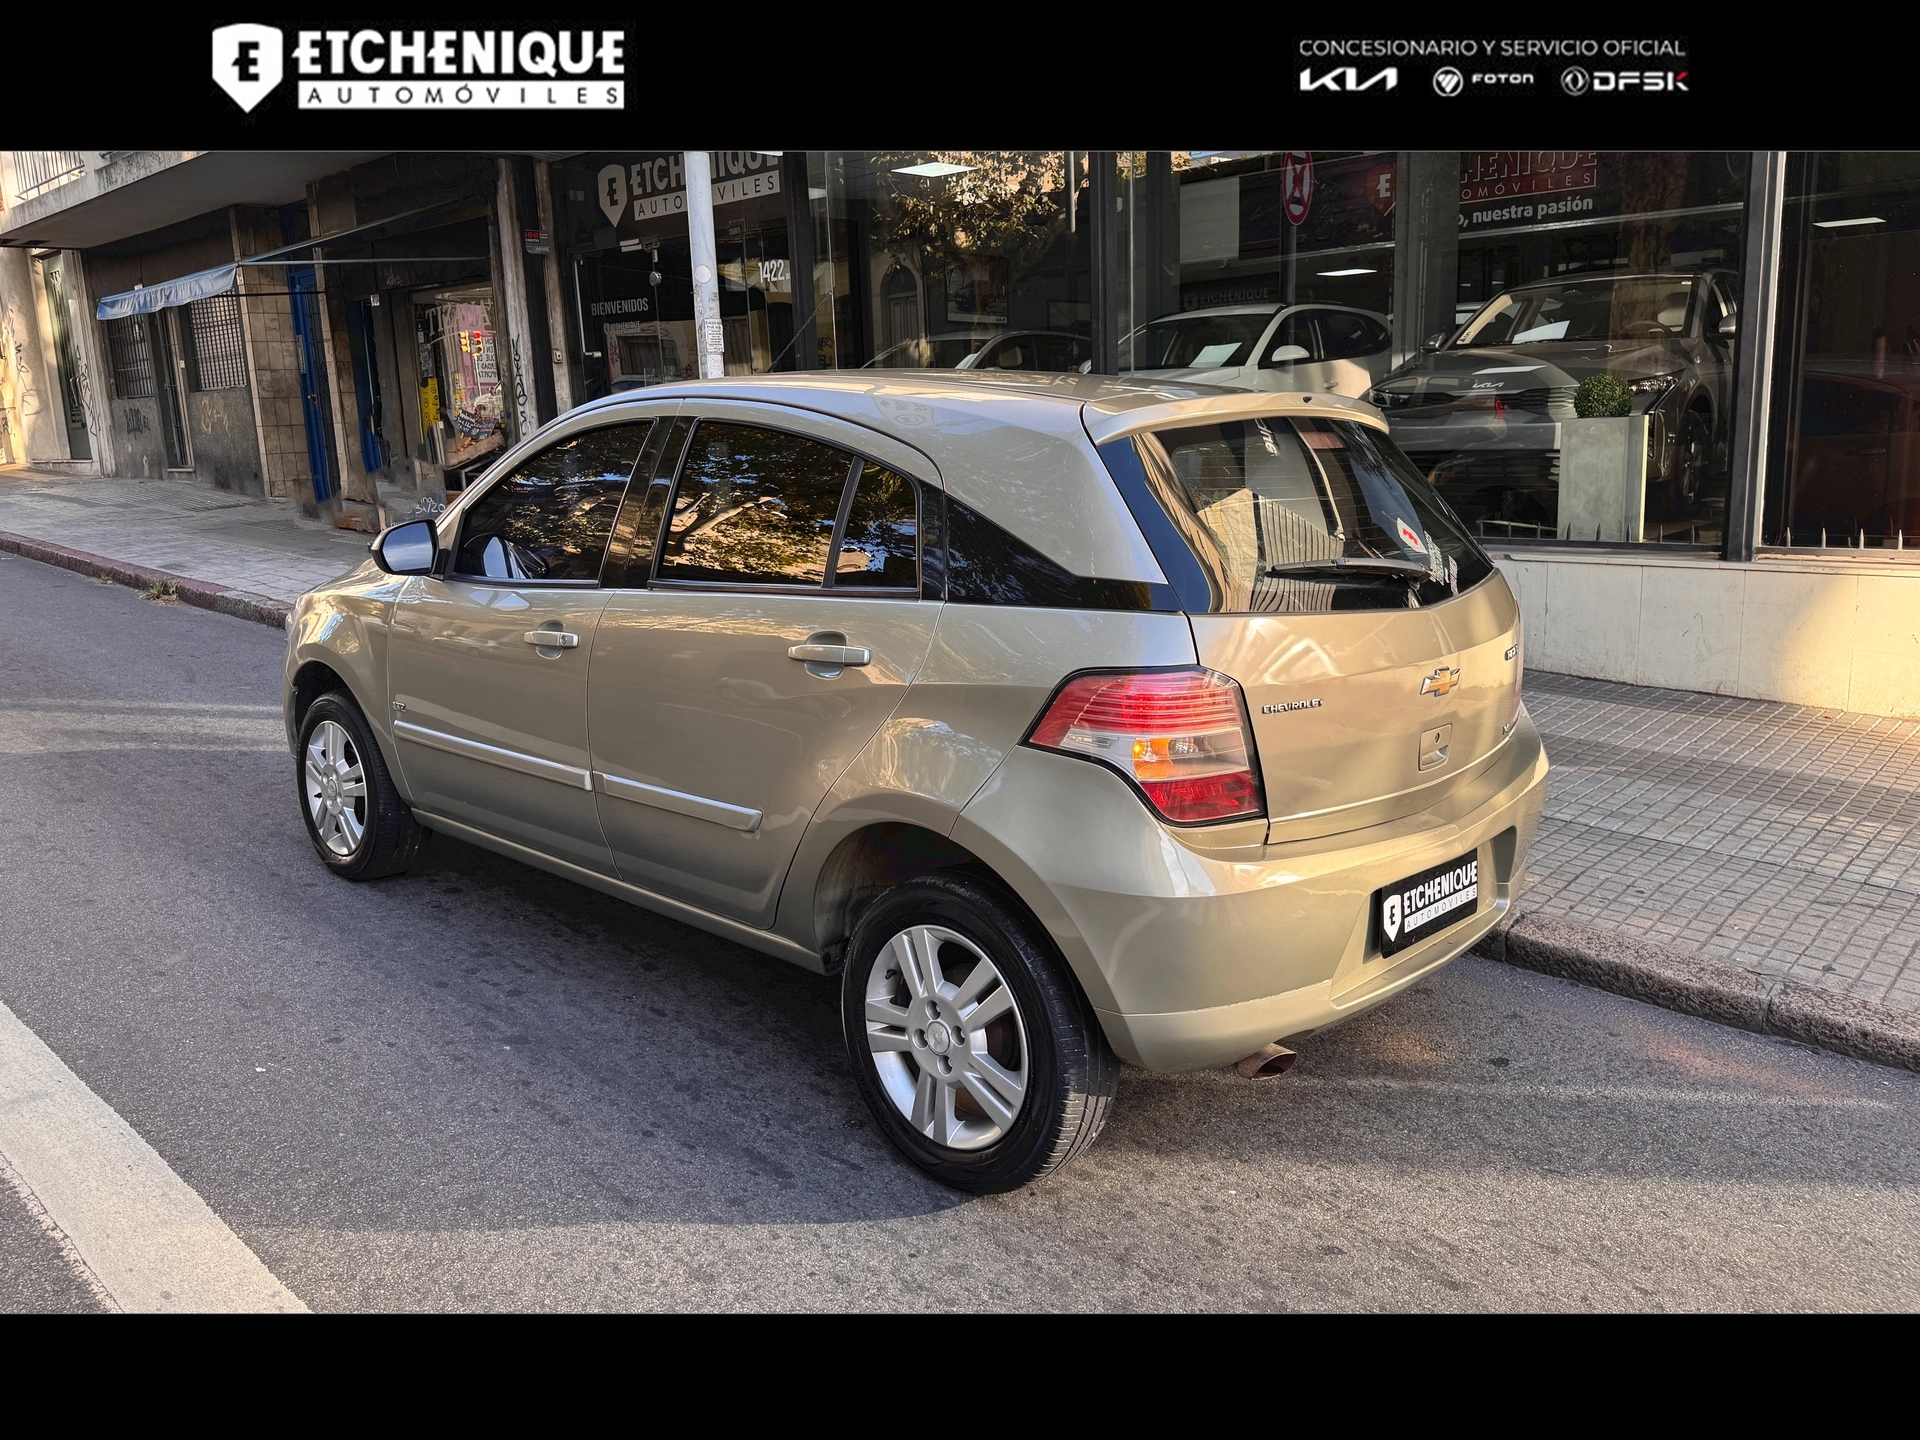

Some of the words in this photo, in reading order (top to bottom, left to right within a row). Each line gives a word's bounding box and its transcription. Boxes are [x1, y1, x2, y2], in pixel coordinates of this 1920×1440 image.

[1472, 204, 1533, 224] nuestra
[1537, 195, 1594, 220] pasión
[757, 259, 785, 284] 1422
[591, 297, 650, 316] BIENVENIDOS
[1403, 860, 1478, 916] ETCHENIQUE
